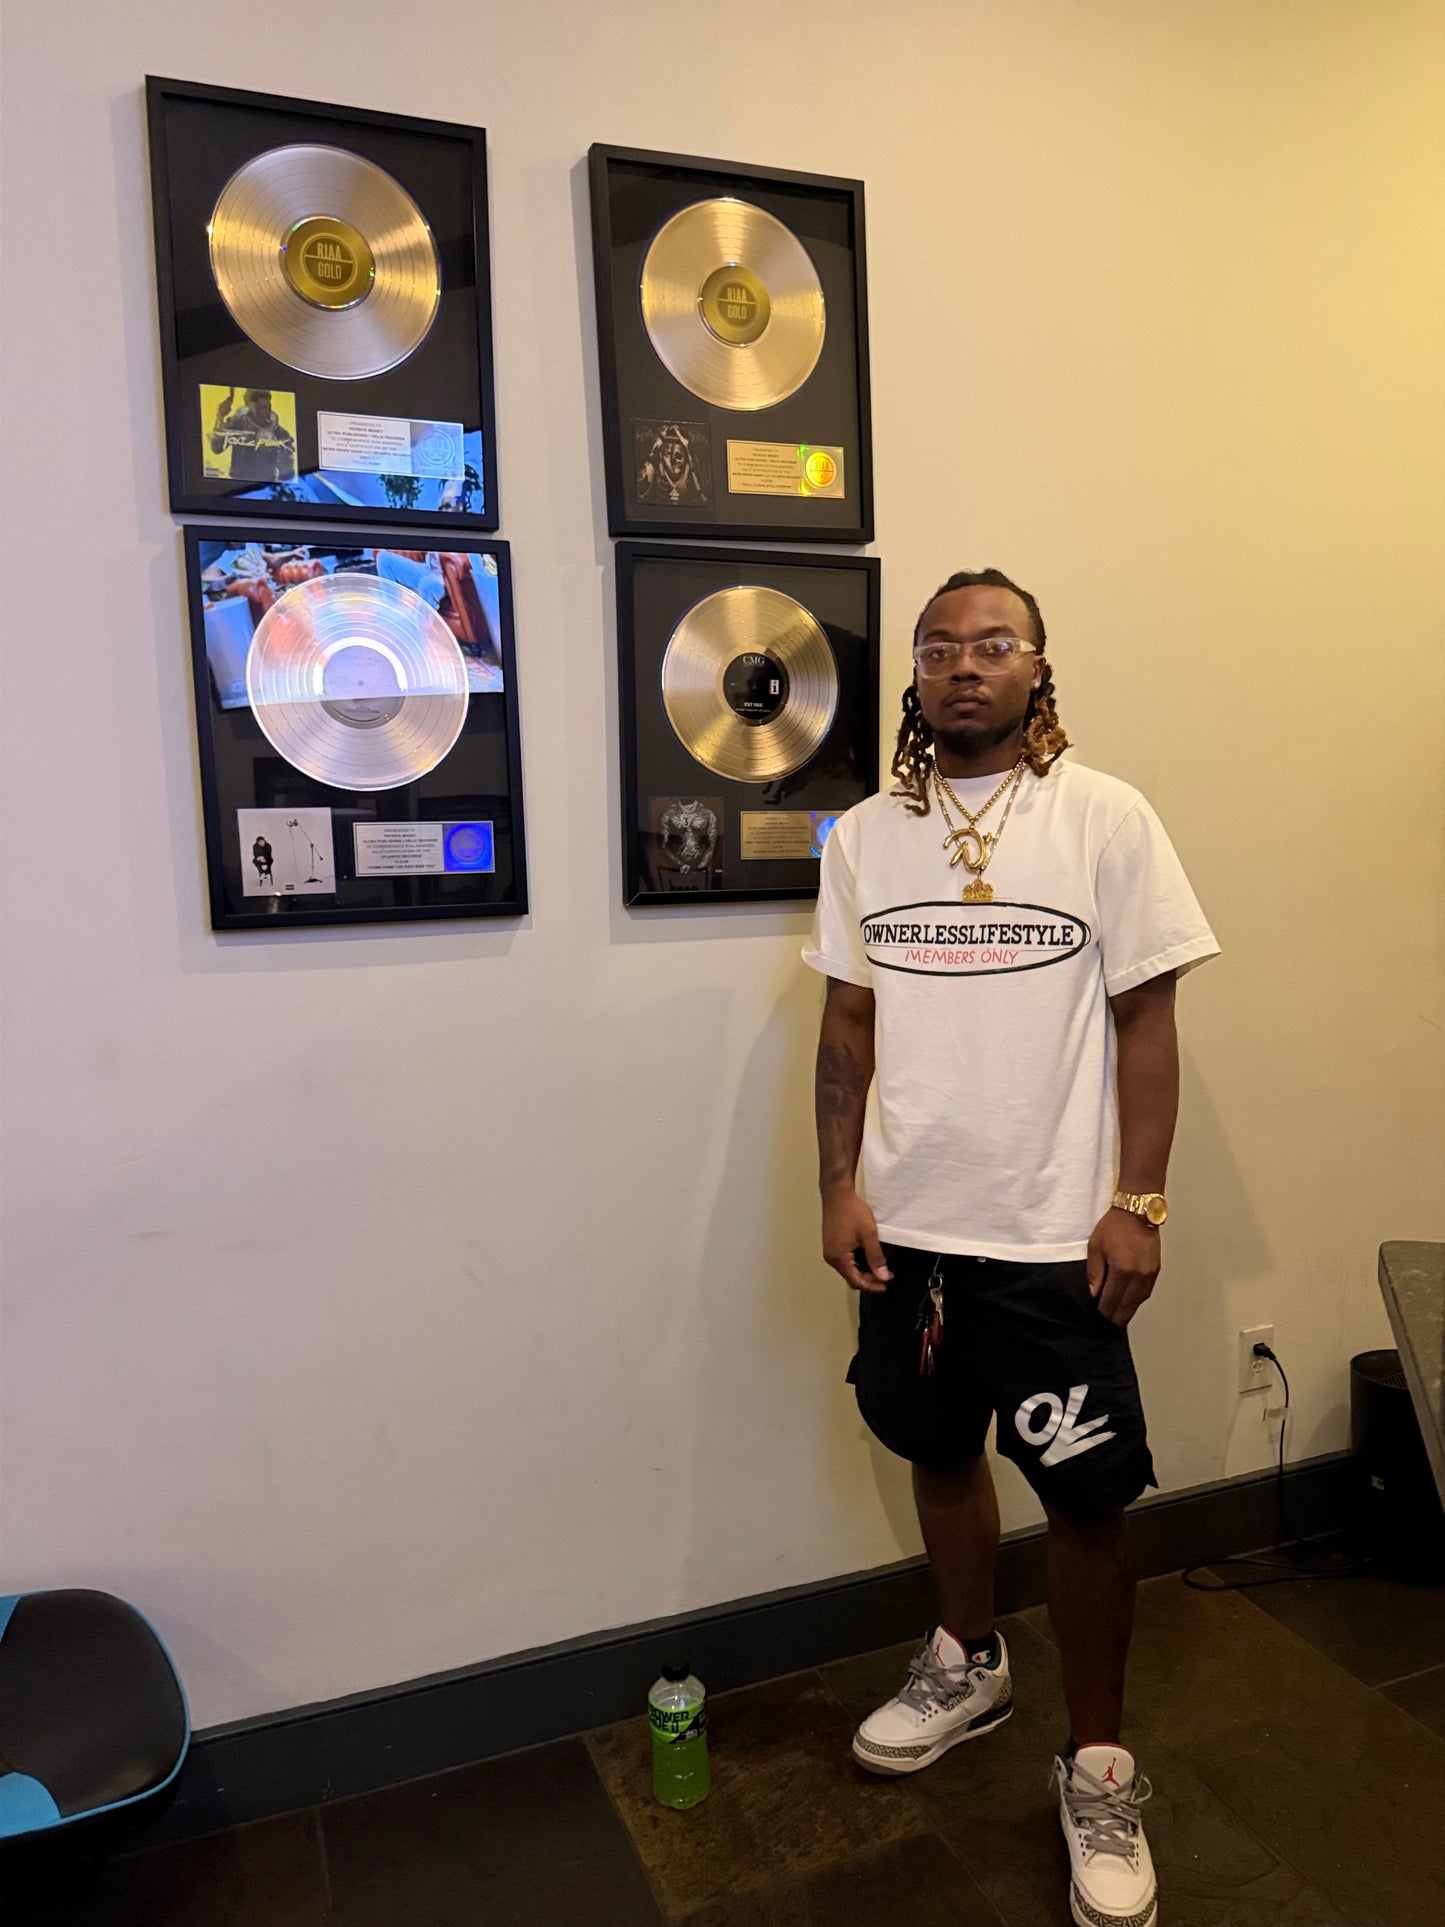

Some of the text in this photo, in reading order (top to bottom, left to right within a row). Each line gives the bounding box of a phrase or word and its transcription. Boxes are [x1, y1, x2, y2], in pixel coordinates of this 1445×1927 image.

[317, 242, 341, 260] RIAA
[318, 262, 341, 279] GOLD
[727, 287, 747, 303] RIAA
[727, 304, 747, 319] GOLD
[743, 655, 765, 665] CMG
[864, 924, 1074, 946] OWNERLESSLIFESTYLE
[905, 949, 1019, 966] MEMBERS ONLY
